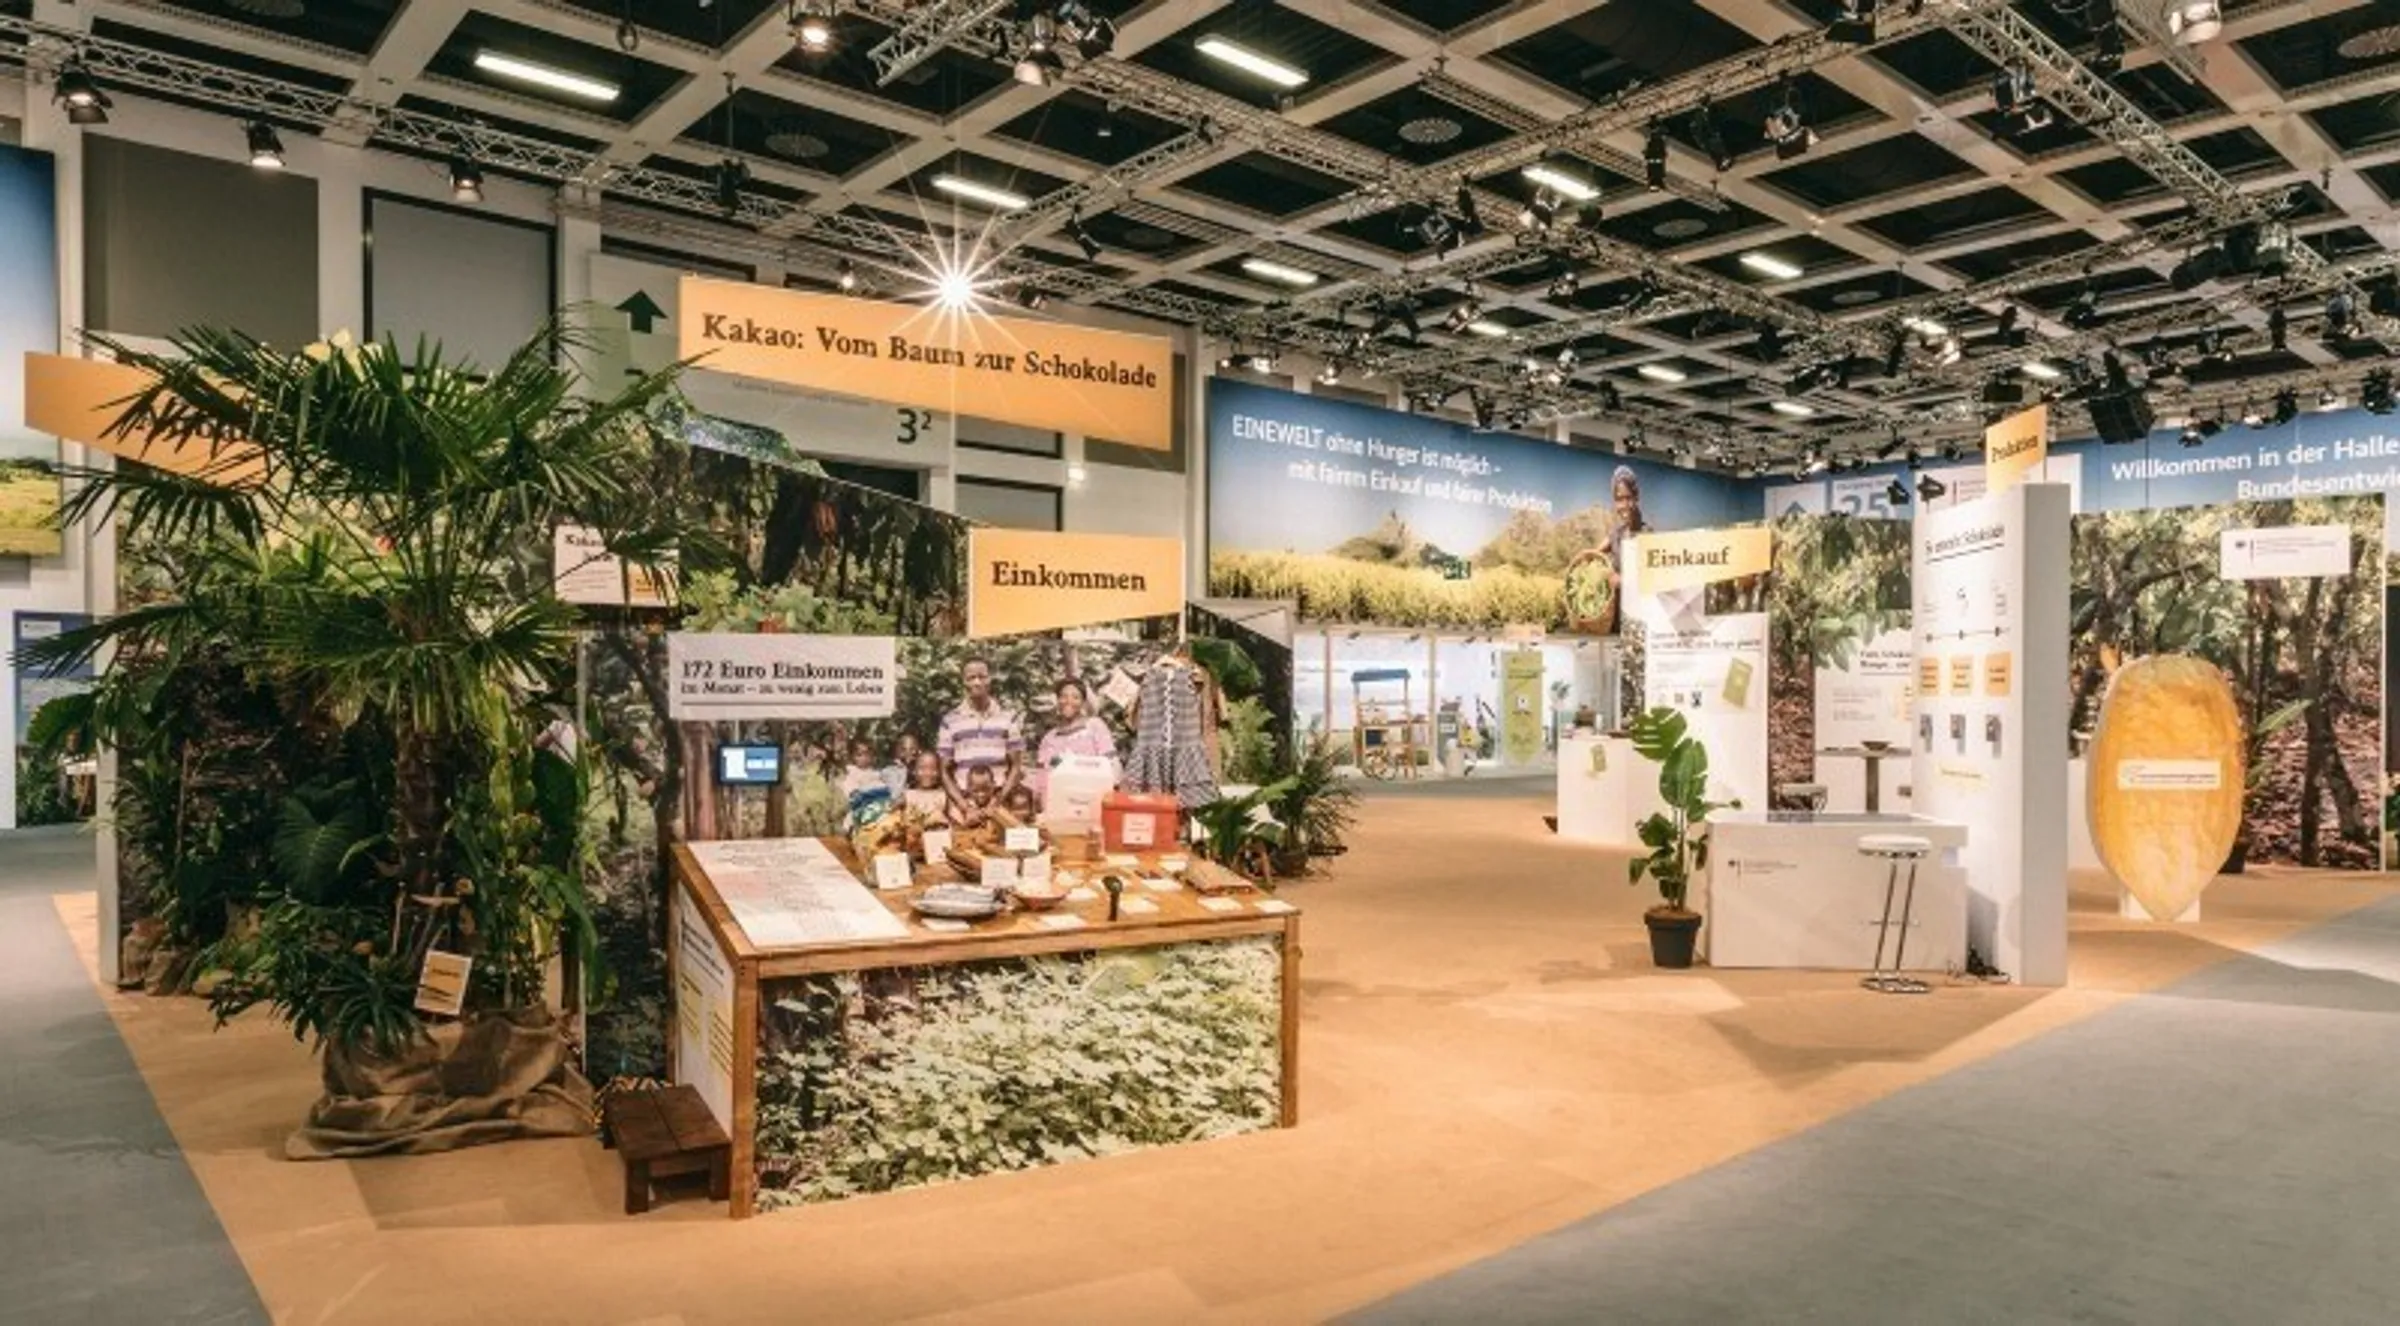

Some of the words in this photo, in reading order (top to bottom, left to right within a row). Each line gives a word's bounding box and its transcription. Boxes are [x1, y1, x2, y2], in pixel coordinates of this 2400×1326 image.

[702, 312, 804, 350] Kakao:
[816, 325, 878, 358] Vom
[888, 335, 965, 367] Baum
[975, 351, 1015, 373] zur
[1023, 350, 1157, 388] Schokolade
[1232, 413, 1325, 449] EINEWELT
[1326, 431, 1364, 457] ohne
[1367, 436, 1420, 467] Hunger
[1422, 445, 1439, 468] ist
[2111, 454, 2251, 481] Willkommen
[2257, 446, 2280, 468] in
[2286, 442, 2327, 466] der
[2334, 434, 2400, 460] Halle
[1288, 458, 1317, 481] mit
[1370, 468, 1424, 496] Einkauf
[1425, 480, 1450, 500] und
[1488, 485, 1553, 514] Produktion
[991, 559, 1147, 591] Einkommen
[1646, 546, 1731, 569] Einkauf
[682, 659, 713, 680] 172
[720, 661, 767, 680] Euro
[772, 662, 884, 680] Einkommen
[702, 681, 745, 695] Monat
[778, 682, 814, 696] wenig
[846, 681, 884, 695] Leben
